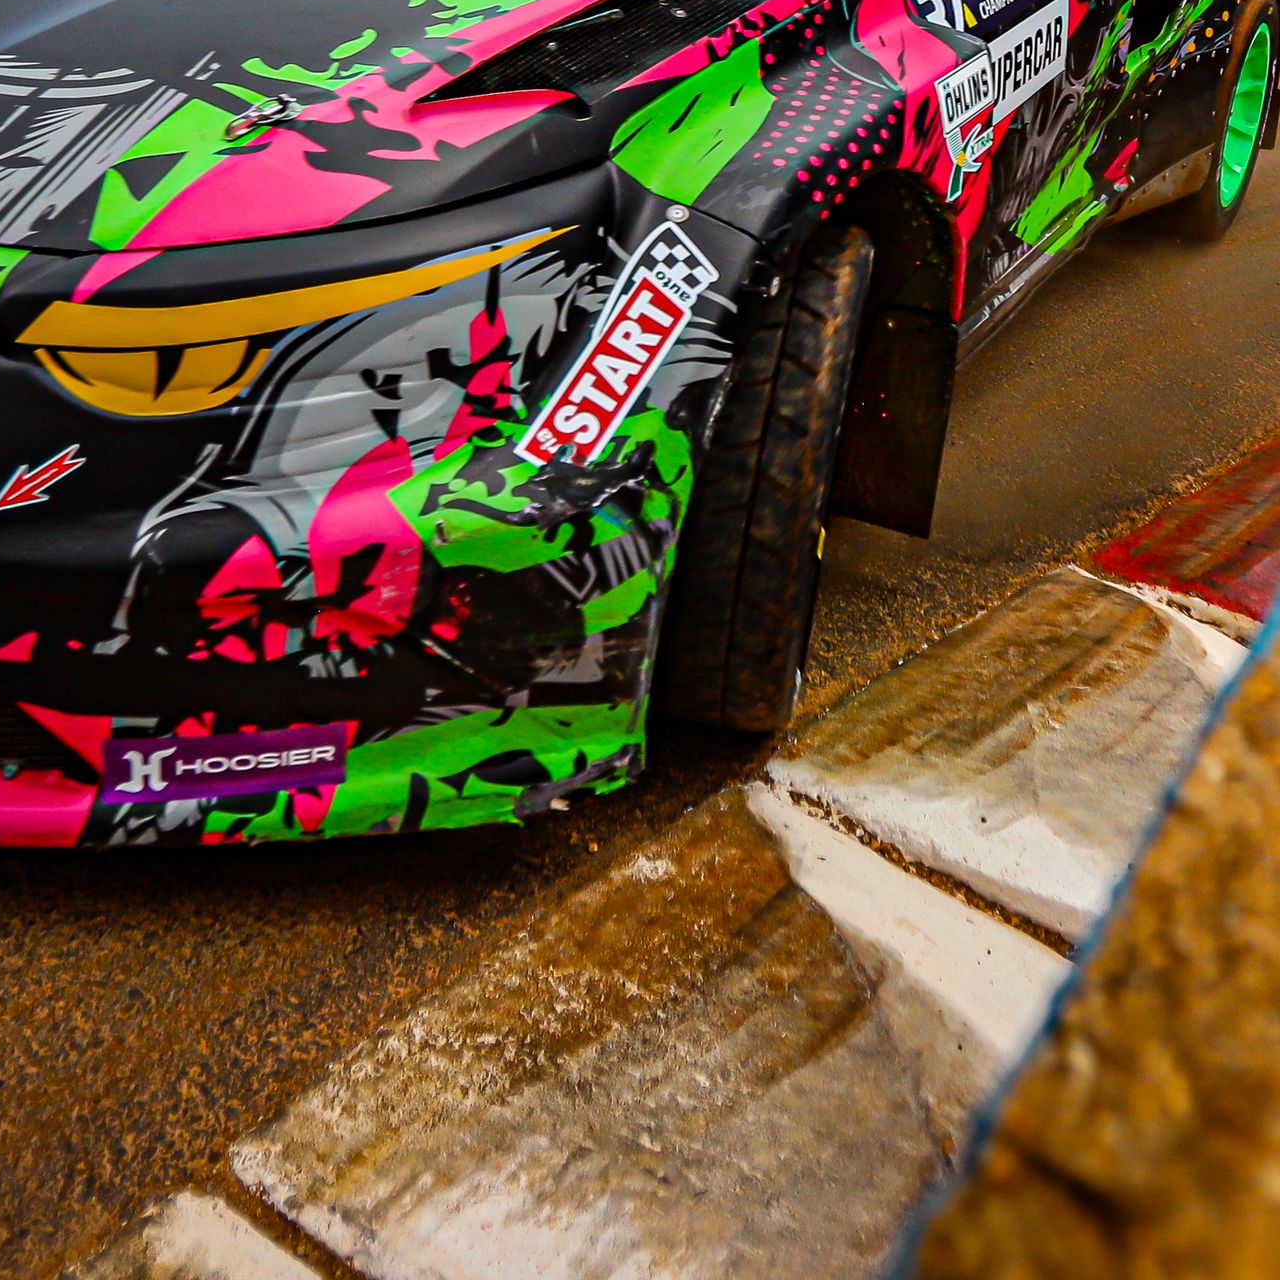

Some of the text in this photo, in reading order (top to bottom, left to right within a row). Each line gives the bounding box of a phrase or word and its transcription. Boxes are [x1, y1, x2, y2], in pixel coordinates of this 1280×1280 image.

[991, 15, 1064, 110] UPERCAR
[943, 67, 990, 123] ÖHLINS
[654, 269, 691, 303] auto
[551, 287, 677, 446] START
[174, 744, 337, 777] HOOSIER
